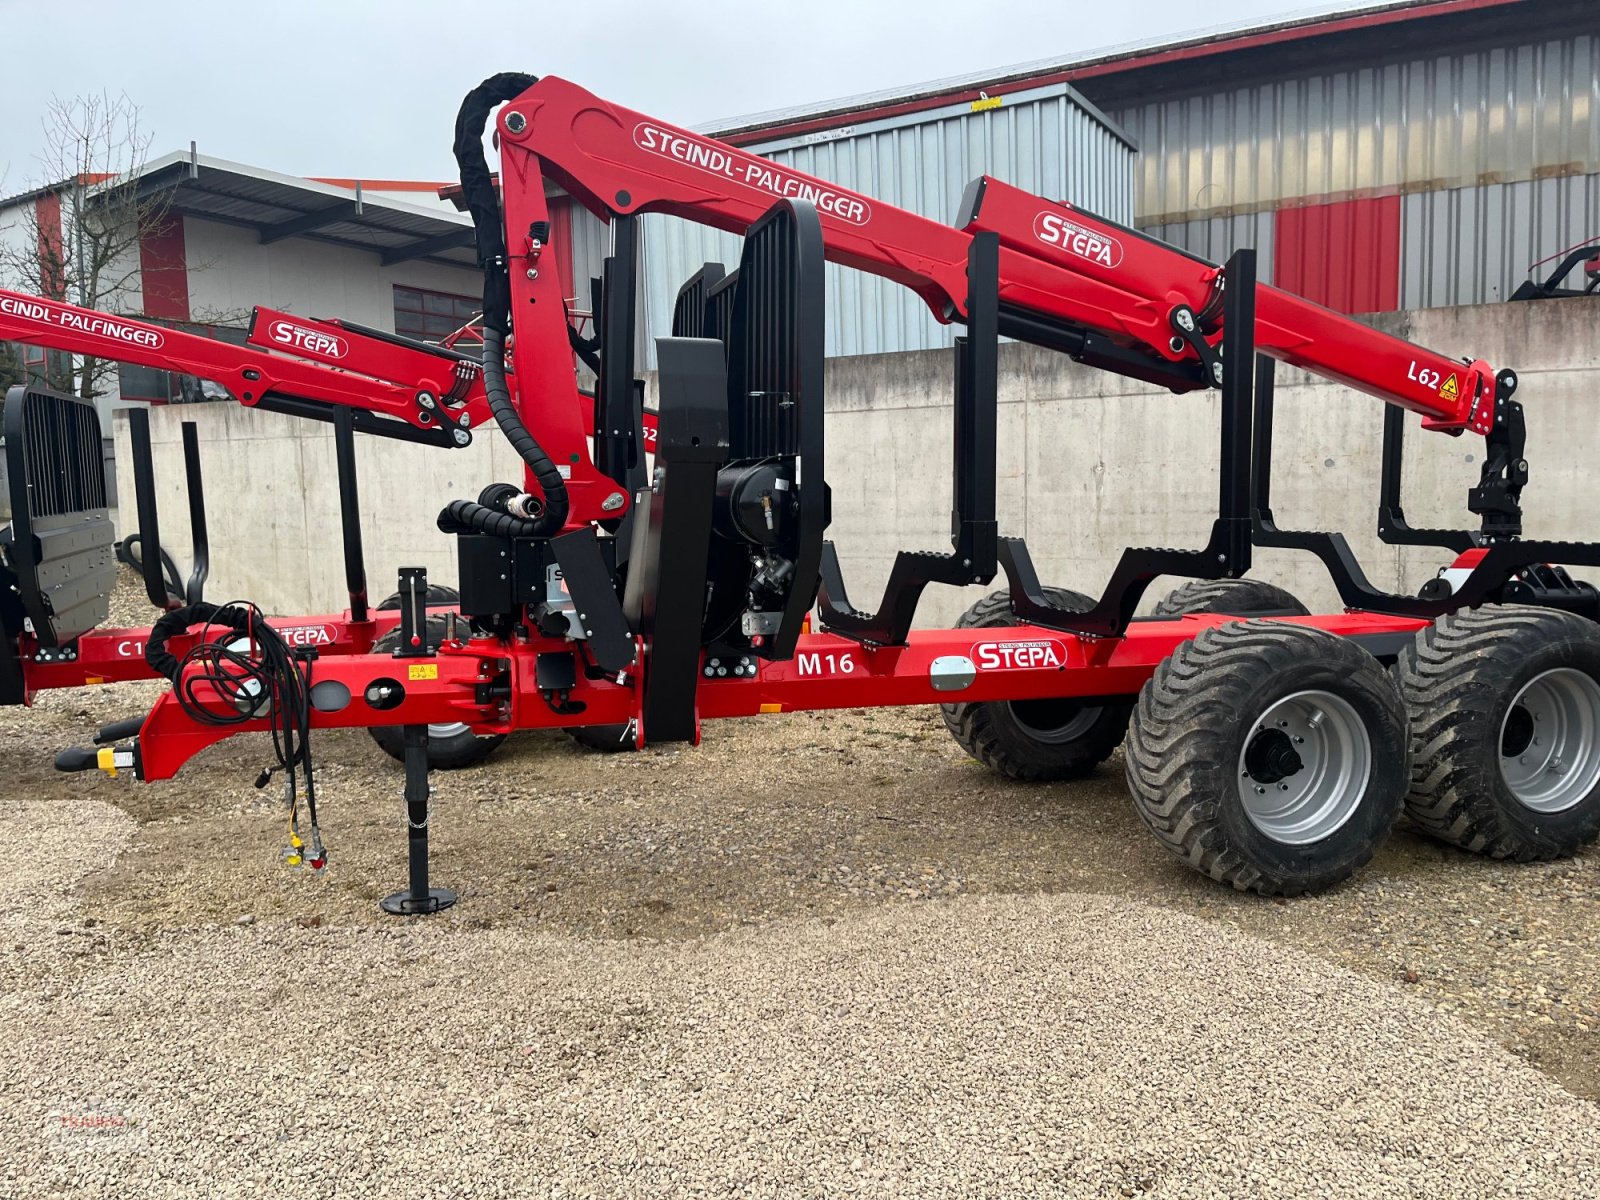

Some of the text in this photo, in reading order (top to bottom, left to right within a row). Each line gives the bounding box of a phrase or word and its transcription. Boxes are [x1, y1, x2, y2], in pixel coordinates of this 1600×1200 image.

[641, 127, 863, 221] STEINDL-PALFINGER
[1040, 215, 1111, 266] STEPA
[0, 297, 158, 347] EINDL-PALFINGER
[275, 323, 339, 357] STEPA
[1407, 361, 1440, 390] L62
[275, 628, 330, 645] TEPA
[978, 643, 1060, 669] STEPA
